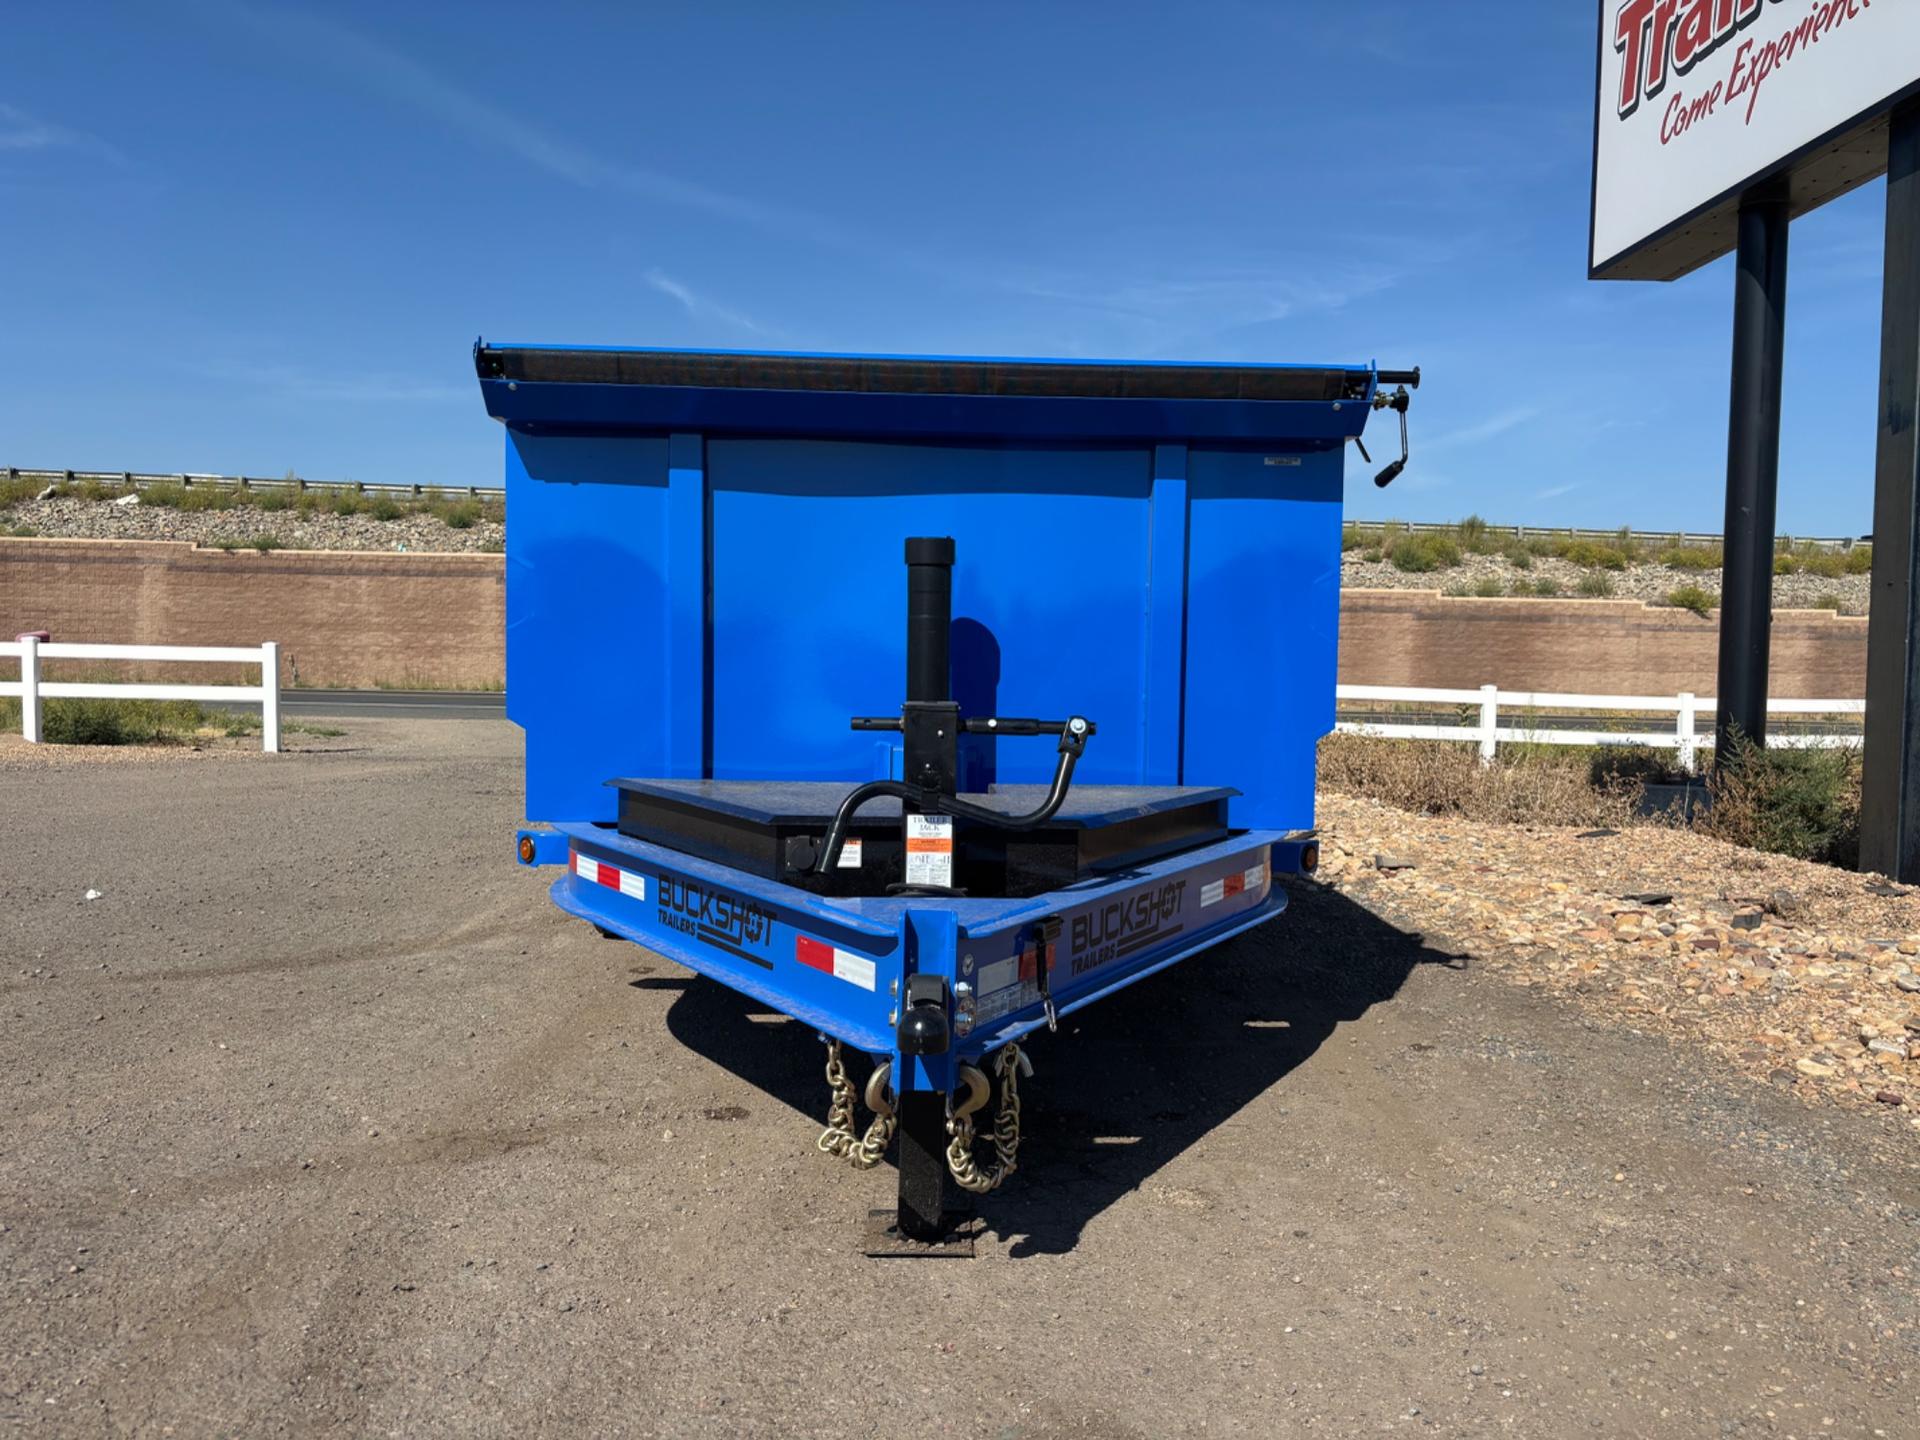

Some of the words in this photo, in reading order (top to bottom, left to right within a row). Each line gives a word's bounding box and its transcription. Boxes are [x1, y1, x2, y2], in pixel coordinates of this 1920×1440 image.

[1660, 80, 1723, 145] Come
[1724, 0, 1870, 125] Experien
[658, 872, 777, 947] BUCKSHOT
[658, 908, 696, 937] TRAILERS
[1071, 880, 1186, 956] BUCKSHOT
[1071, 942, 1117, 977] TRAILERS
